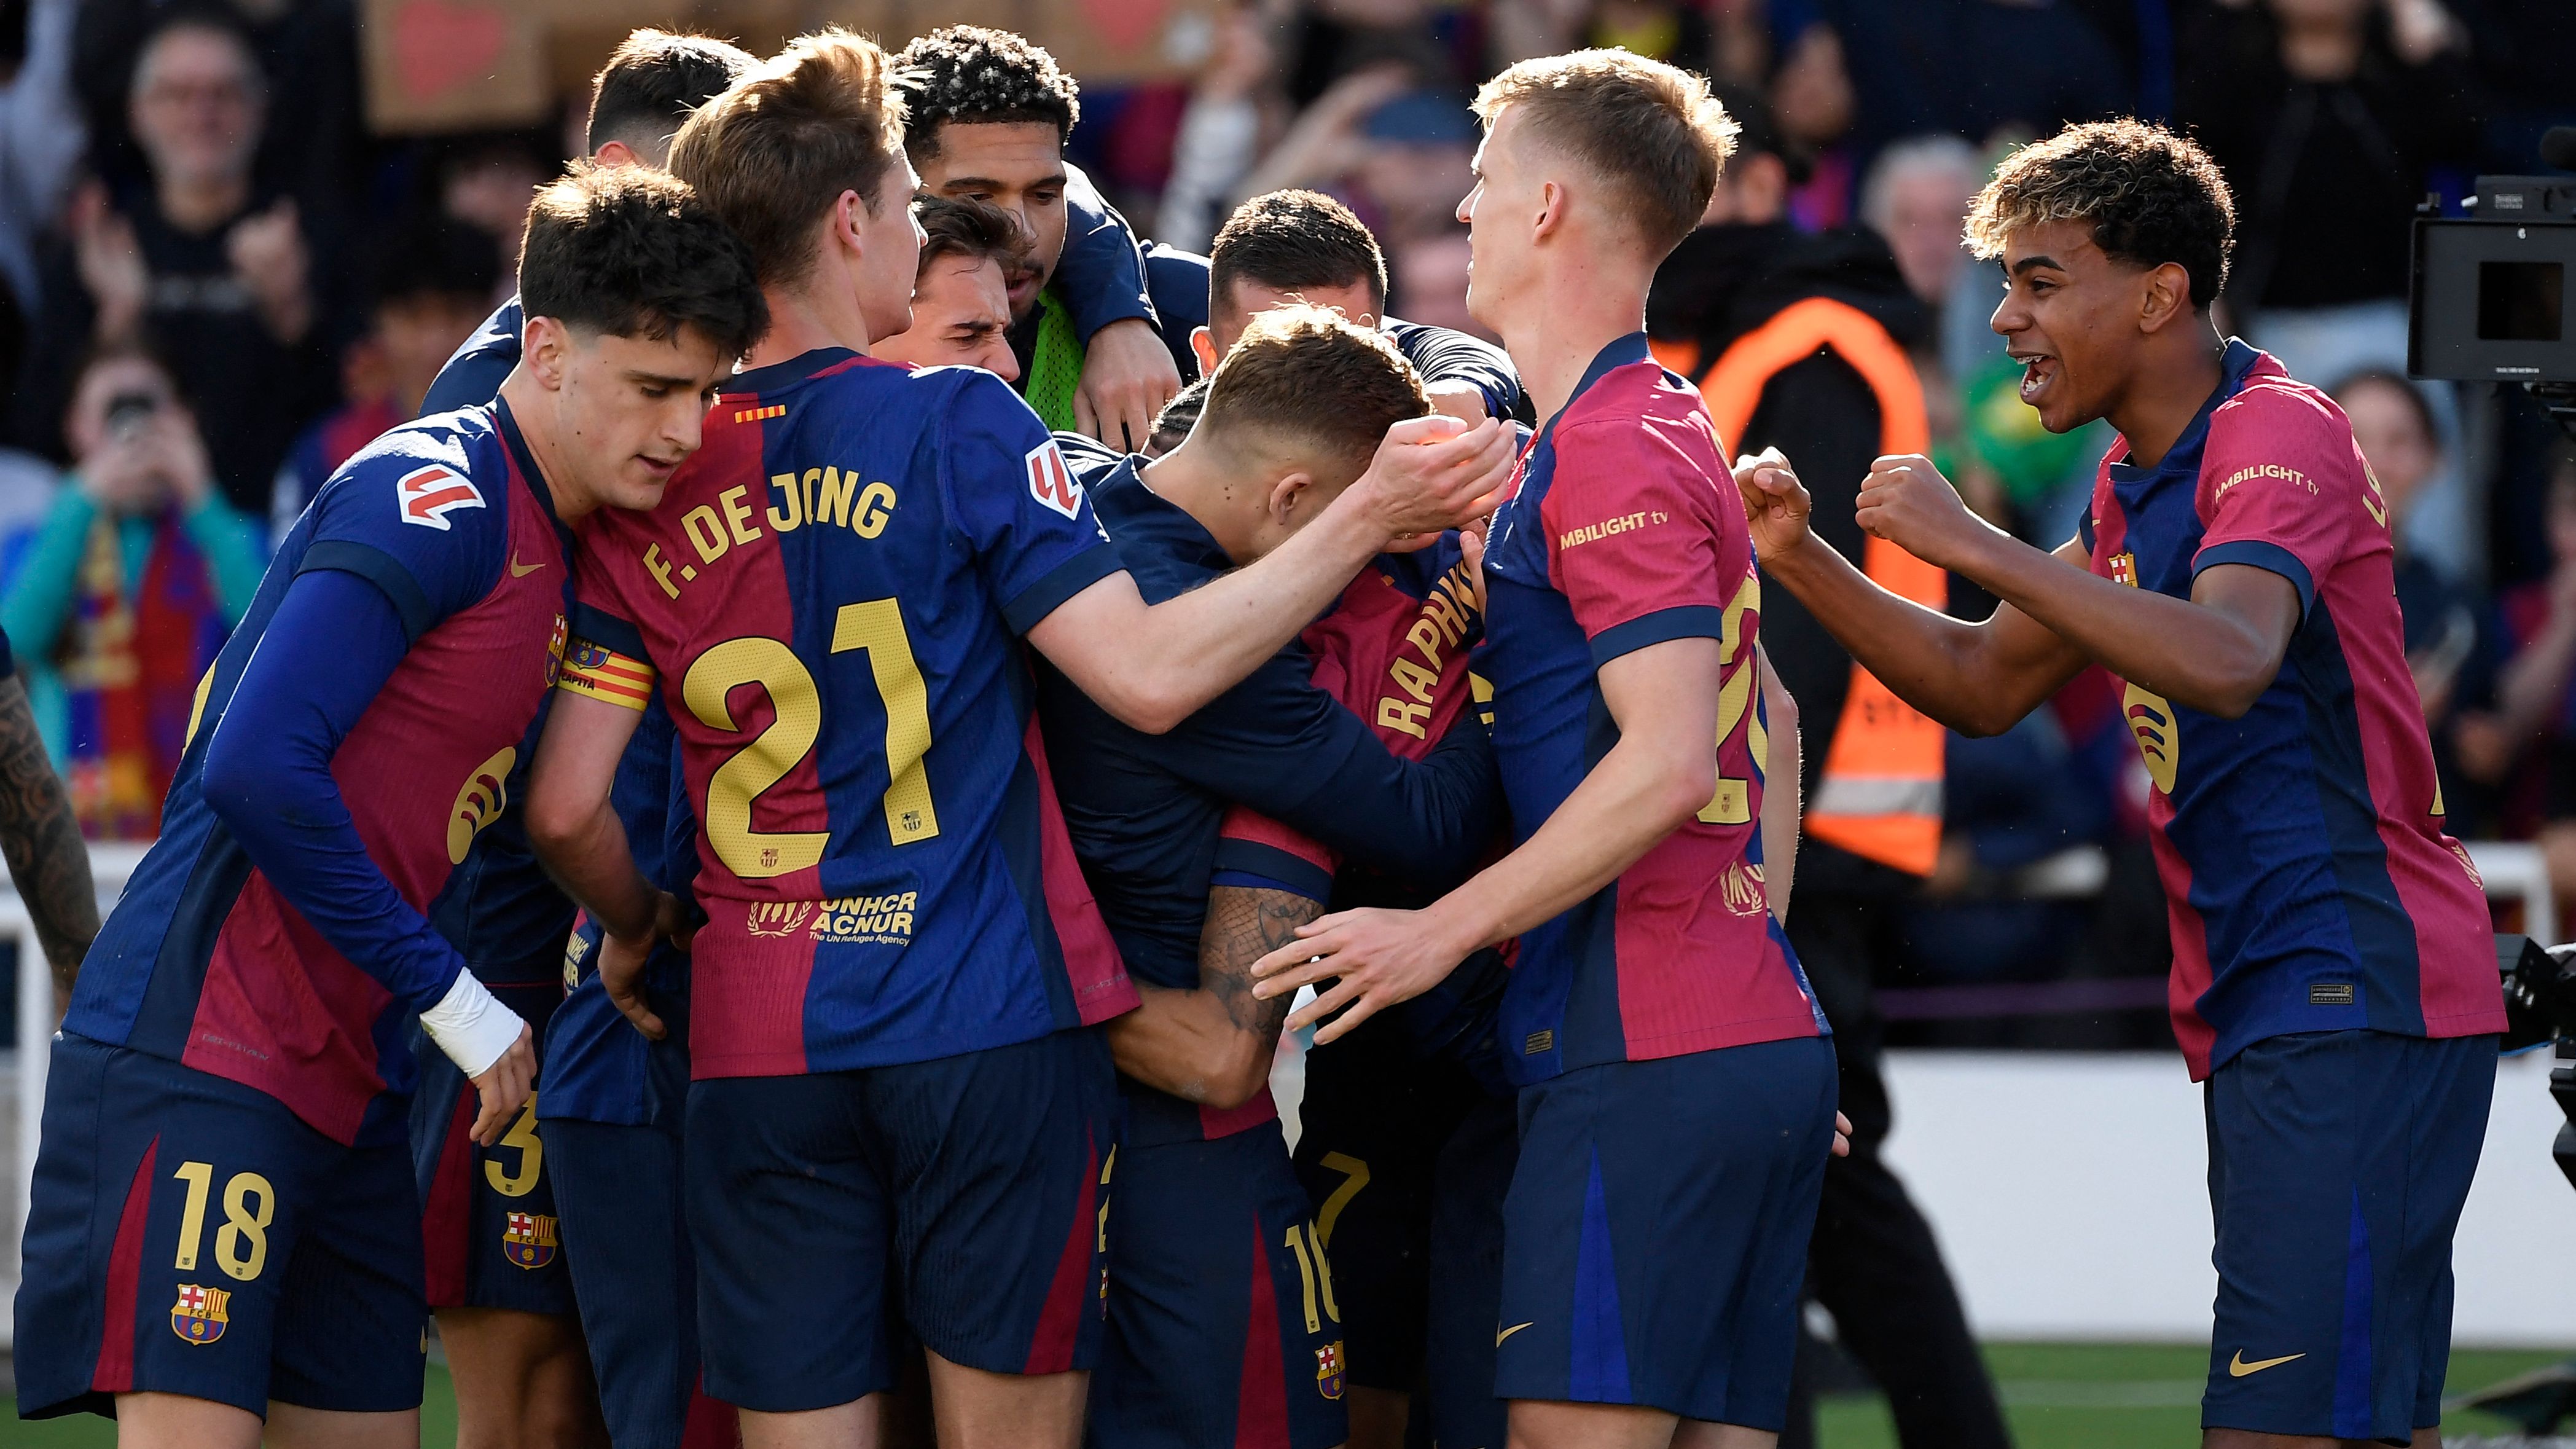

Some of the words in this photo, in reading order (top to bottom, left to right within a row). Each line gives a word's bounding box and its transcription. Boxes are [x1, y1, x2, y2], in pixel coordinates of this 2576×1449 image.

[2215, 464, 2304, 504] AMBILIGHT
[2307, 479, 2320, 497] tv
[1650, 510, 1669, 525] tv
[643, 541, 698, 600] F.
[680, 484, 762, 565] DE
[765, 466, 897, 540] JONG
[562, 672, 595, 691] CAPITÀ
[682, 596, 941, 878] 21
[819, 891, 917, 916] UNHCR
[809, 912, 914, 935] ACNUR
[809, 932, 825, 941] The
[826, 934, 841, 943] UN
[841, 935, 875, 944] Refugee
[875, 933, 910, 947] Agency
[484, 1091, 542, 1197] 3
[173, 1161, 275, 1282] 18
[190, 1309, 211, 1319] FCB
